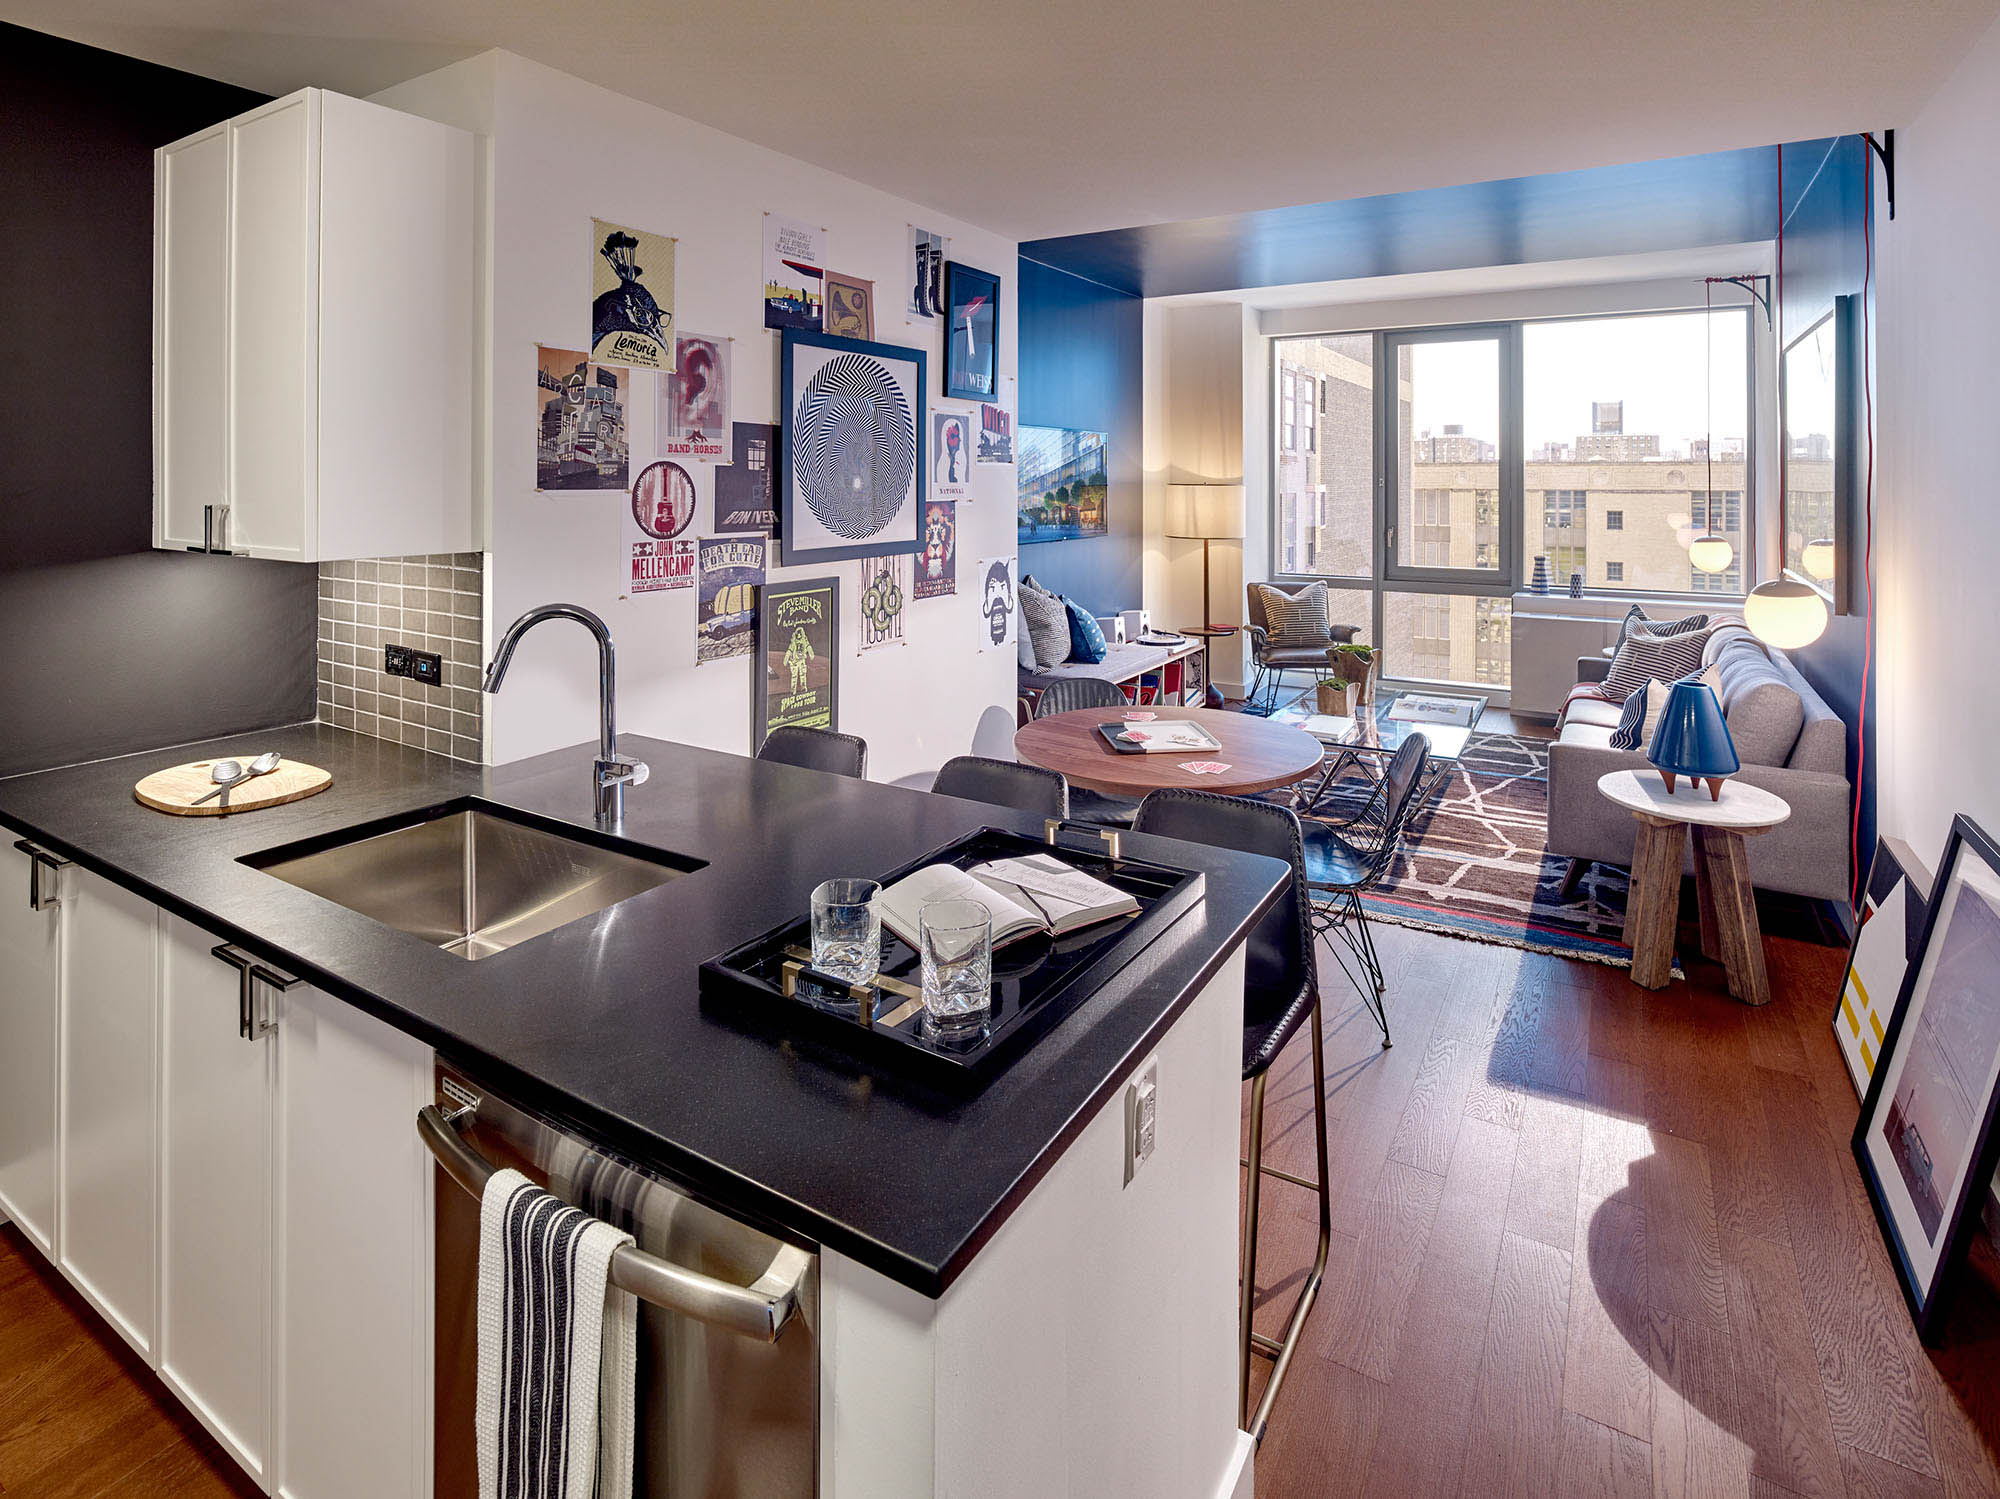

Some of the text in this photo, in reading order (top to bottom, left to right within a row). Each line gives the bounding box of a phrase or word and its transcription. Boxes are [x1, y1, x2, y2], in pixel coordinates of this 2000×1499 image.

[614, 332, 657, 356] Lemuria
[667, 443, 723, 454] BAND HORSES
[722, 510, 779, 525] BON IVER
[655, 540, 673, 556] JOHN
[702, 543, 761, 559] DEATH CAB
[632, 555, 694, 580] MELLENCAMP
[703, 554, 725, 568] FOR
[729, 552, 760, 564] CUTIE
[789, 605, 809, 616] BAND
